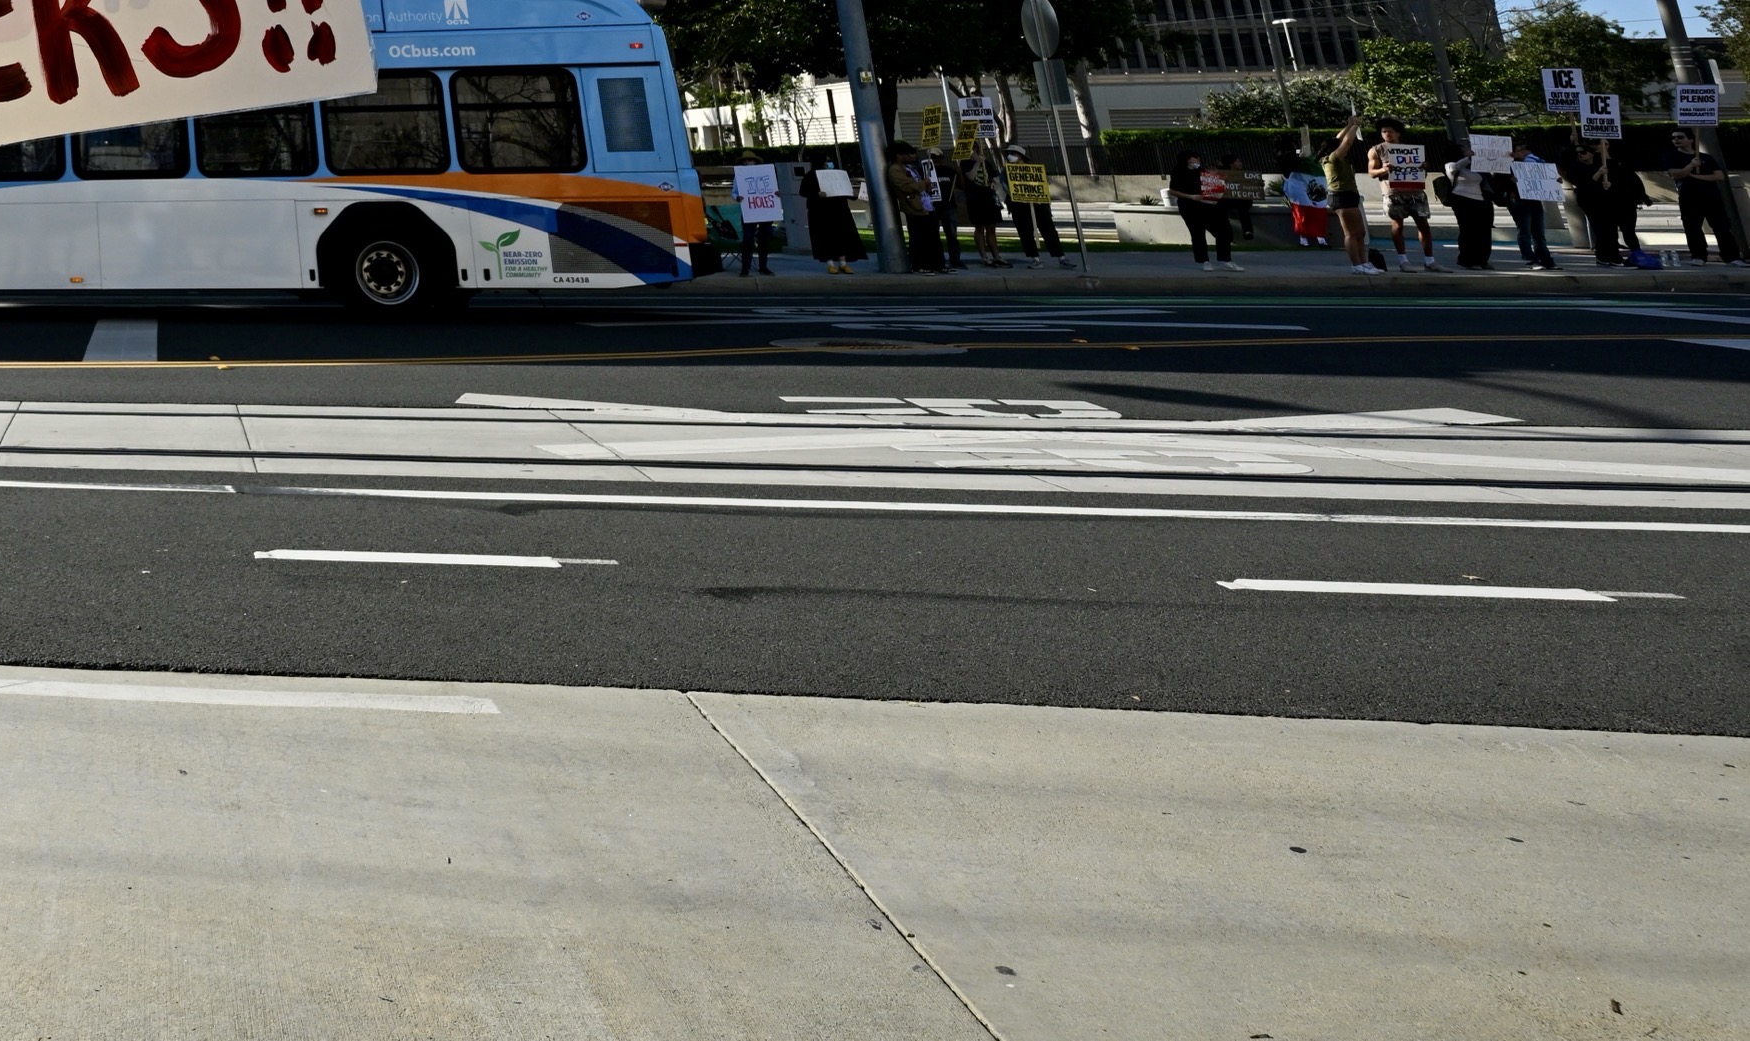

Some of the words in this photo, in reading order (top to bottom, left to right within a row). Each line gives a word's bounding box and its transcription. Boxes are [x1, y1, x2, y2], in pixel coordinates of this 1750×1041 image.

[387, 10, 443, 25] Authority
[388, 44, 476, 59] OCbus.com
[1552, 70, 1576, 88] ICE
[1680, 95, 1716, 103] PLENOS
[1590, 96, 1612, 115] ICE
[962, 108, 981, 117] JUSTICE
[1396, 156, 1421, 164] DUE
[1009, 172, 1045, 182] GENERAL
[745, 176, 774, 194] ICE
[1014, 184, 1044, 194] STRIKE!
[1231, 190, 1261, 198] PEOPLE
[748, 195, 774, 209] HOLES
